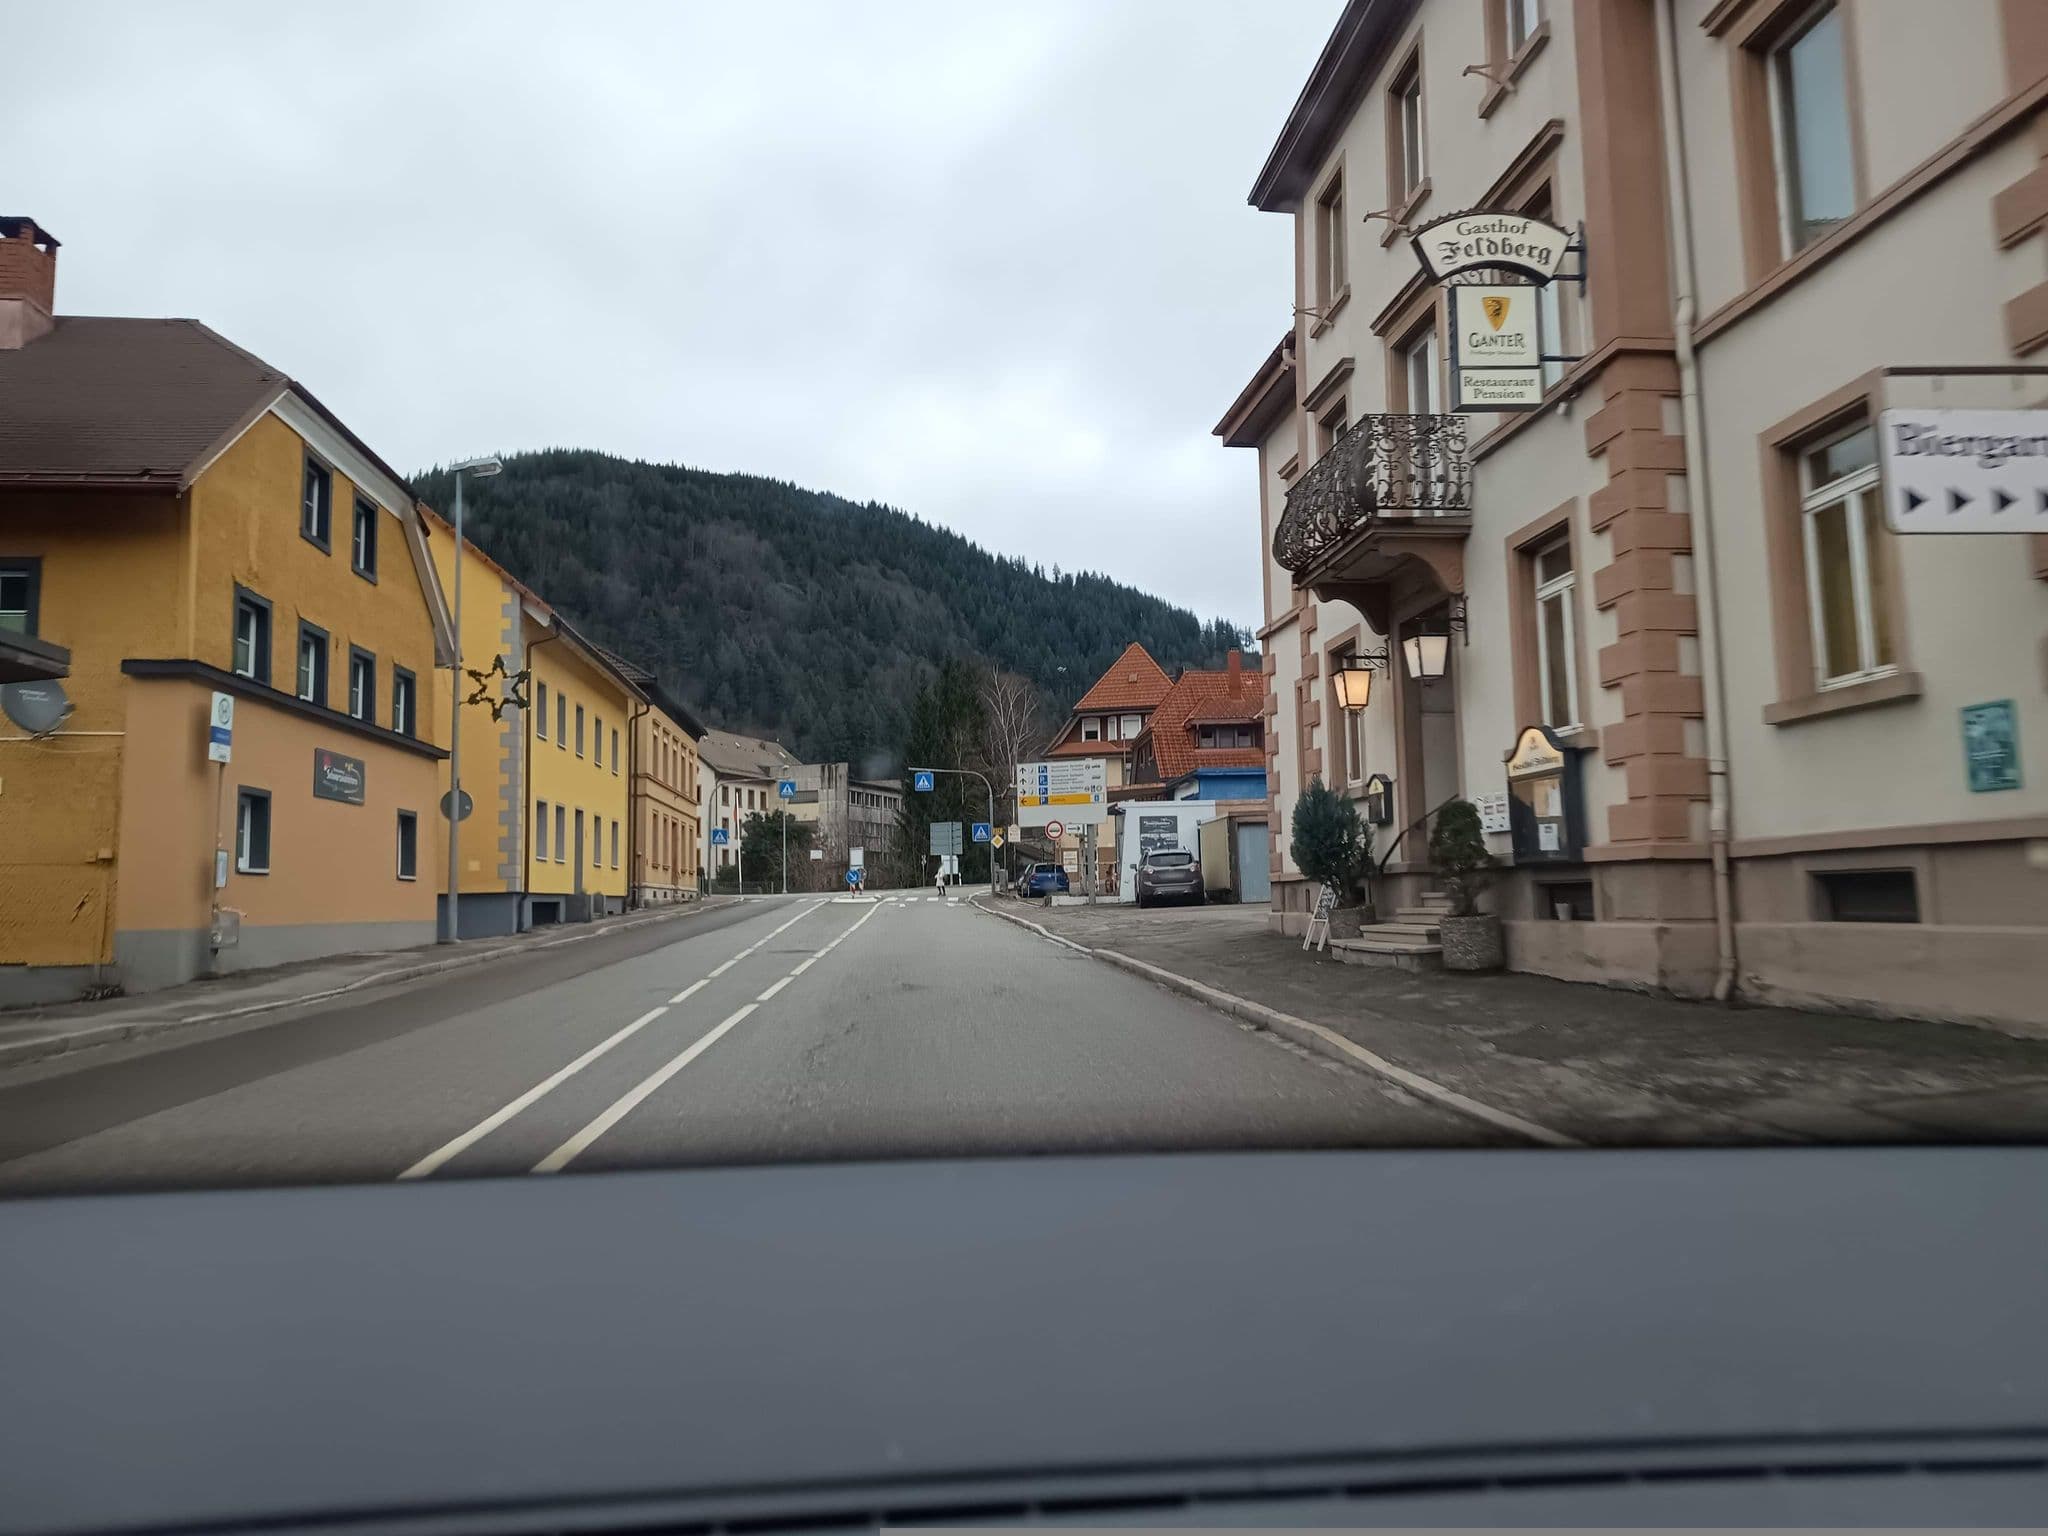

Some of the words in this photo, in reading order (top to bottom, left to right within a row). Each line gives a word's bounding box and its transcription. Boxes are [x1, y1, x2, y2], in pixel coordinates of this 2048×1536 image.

[1456, 219, 1531, 235] Gasthof
[1438, 237, 1552, 265] Feldberg
[1469, 332, 1525, 348] GANTER
[1464, 376, 1536, 387] Restaurant
[1473, 388, 1526, 399] Pension
